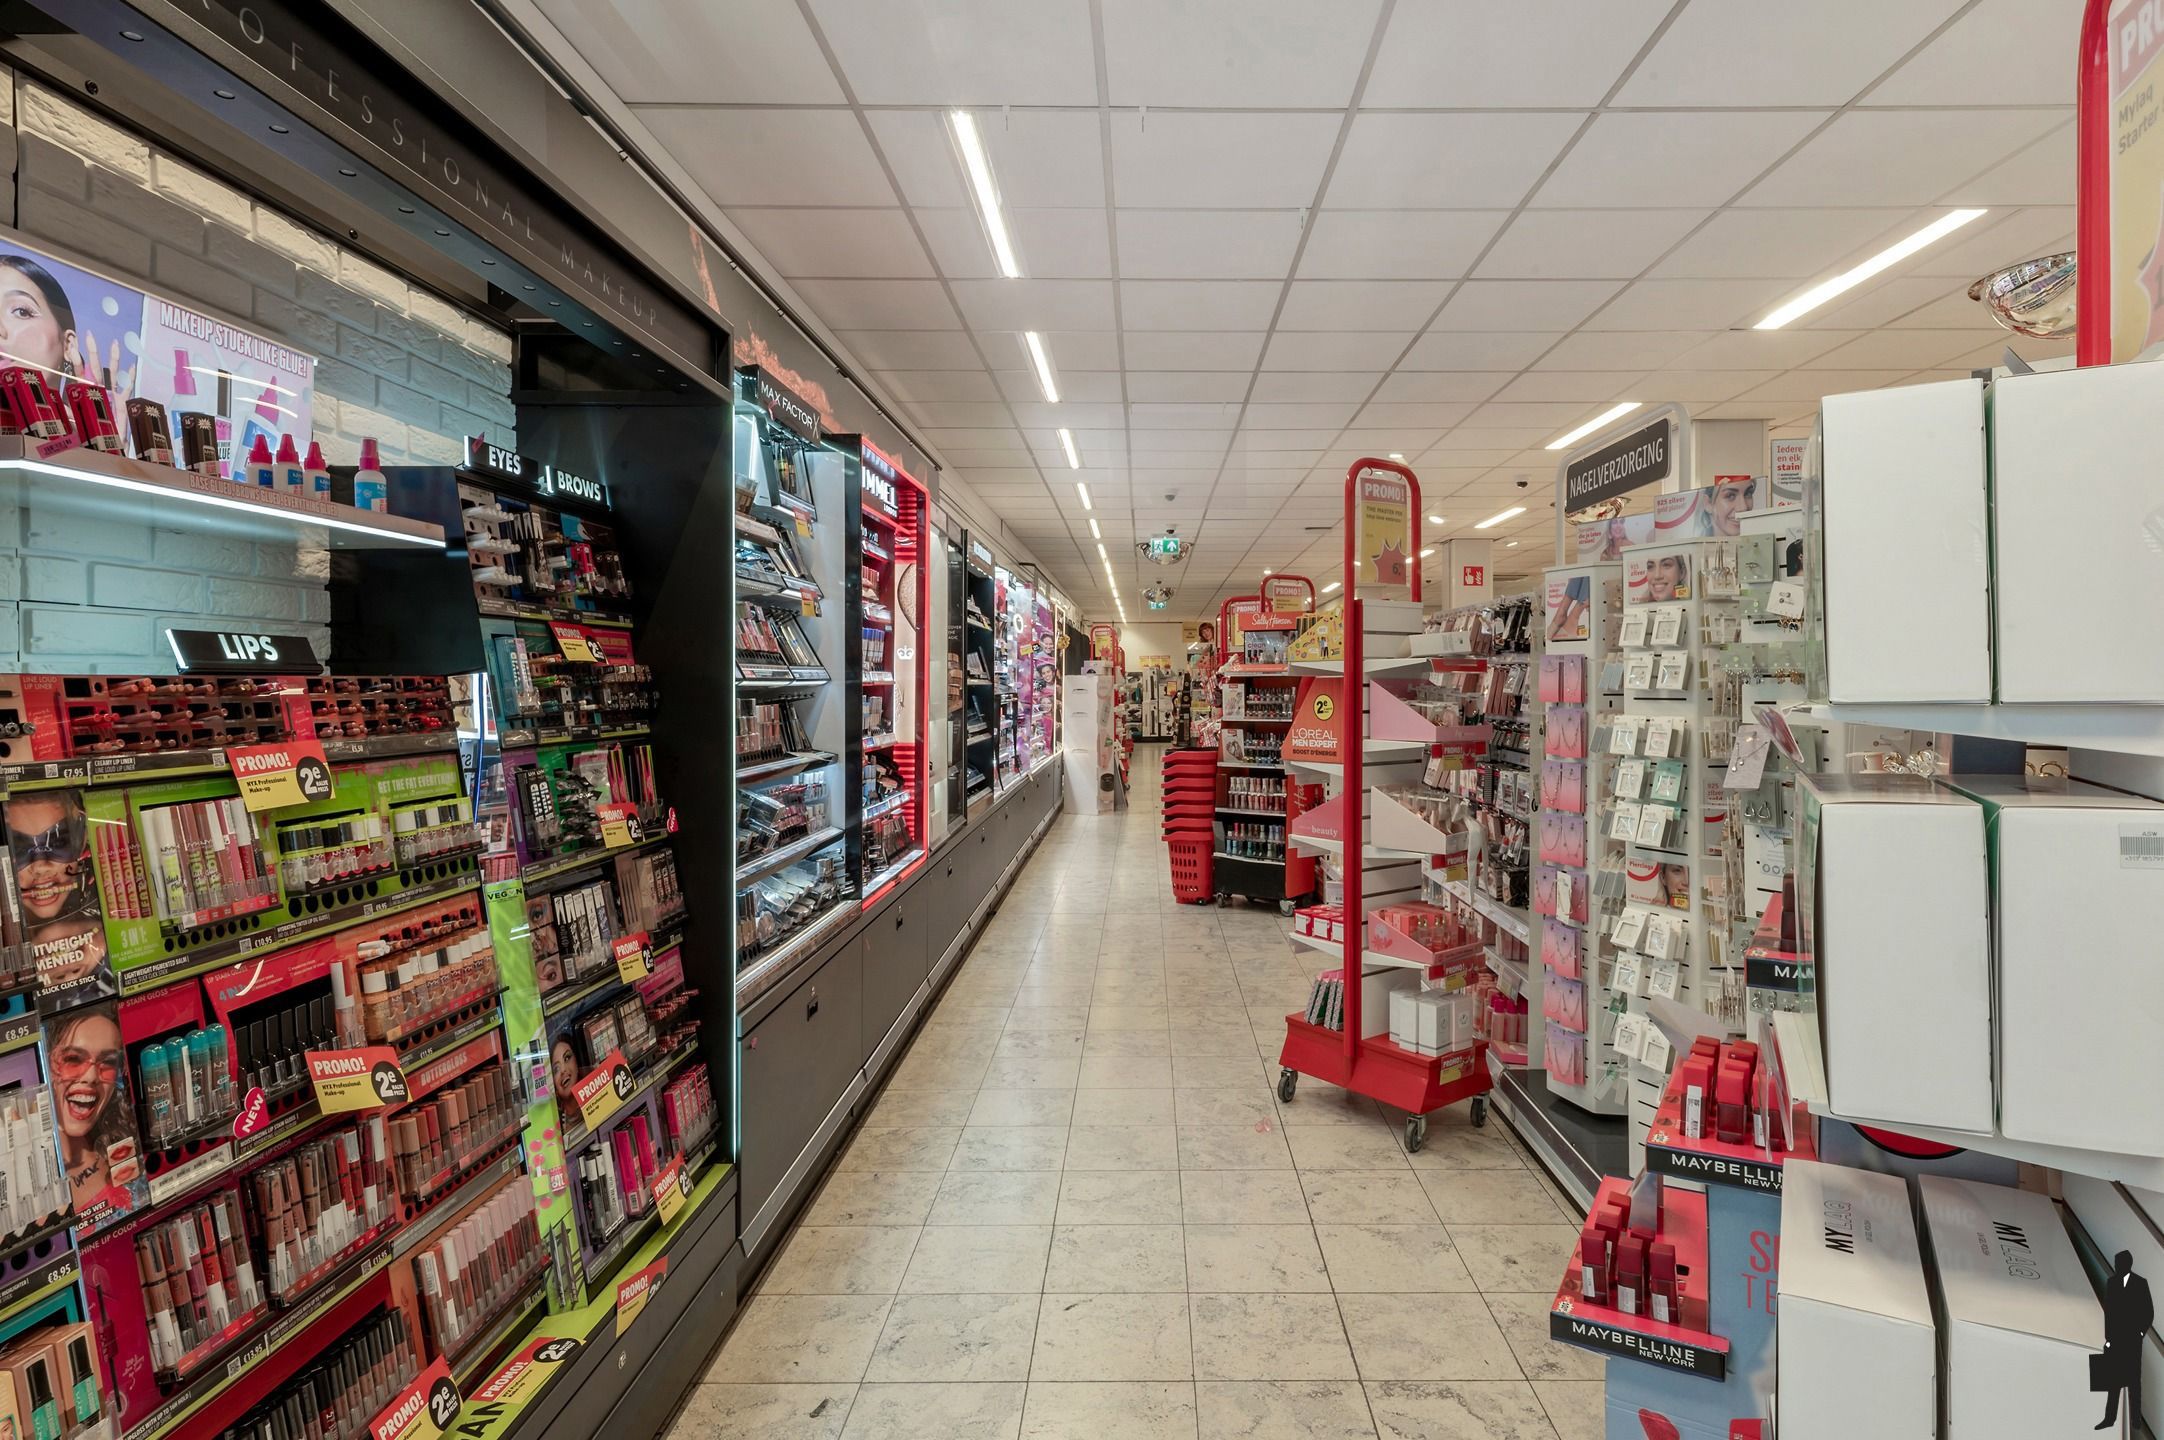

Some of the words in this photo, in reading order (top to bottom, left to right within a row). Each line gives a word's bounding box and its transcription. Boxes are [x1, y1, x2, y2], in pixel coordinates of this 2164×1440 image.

[2119, 84, 2153, 128] Mylaq
[2119, 106, 2159, 154] Starter
[203, 0, 535, 242] OFESSIONAL
[560, 242, 660, 326] MAKEUP
[160, 302, 213, 342] MAKEUP
[215, 323, 252, 358] STUCK
[255, 337, 278, 367] LIKE
[279, 349, 308, 378] GLUE!
[761, 382, 781, 405] MAX
[782, 397, 813, 428] FACTOR
[488, 444, 521, 476] EYES
[1569, 437, 1664, 499] NAGELVERZORGING
[189, 474, 208, 490] BASE
[236, 485, 260, 501] BROWS
[557, 472, 601, 502] BROWS
[1364, 482, 1405, 502] PROMO!
[1276, 587, 1301, 595] PROMO!
[1236, 605, 1259, 613] PROMO!
[1252, 613, 1268, 629] Sally
[1269, 613, 1292, 628] Hansen
[555, 627, 583, 639] PROMO!
[217, 633, 279, 661] LIPS
[1316, 700, 1328, 714] 2e
[1292, 727, 1337, 740] L'ORÉAL
[1292, 739, 1309, 747] MEN
[1309, 739, 1337, 749] EXPERT
[237, 752, 291, 773] PROMO!
[249, 786, 271, 794] Make-up
[257, 777, 287, 786] Professional
[378, 781, 391, 794] GET
[392, 779, 404, 792] THE
[404, 777, 416, 790] FAT
[599, 809, 624, 823] PROMO!
[1311, 824, 1338, 838] beauty
[487, 888, 523, 900] VEGN
[121, 929, 128, 947] 3
[129, 928, 140, 947] IN
[616, 940, 640, 957] PROMO!
[124, 967, 152, 980] LIGHTWEIGHT
[152, 962, 177, 974] PIGMENTED
[216, 970, 230, 980] STAIN
[1446, 963, 1465, 976] PROMO!
[42, 985, 60, 995] SLICK
[126, 994, 148, 1007] STAIN
[148, 988, 169, 1001] GLOSS
[313, 1056, 366, 1077] PROMO!
[147, 1083, 170, 1092] NYX
[324, 1089, 345, 1097] Make-up
[332, 1080, 361, 1088] Professional
[577, 1070, 610, 1102] PROMO!
[242, 1093, 265, 1133] NEW
[654, 1168, 676, 1198] PROMO!
[1744, 1178, 1767, 1186] NEW
[92, 1202, 107, 1213] WET
[94, 1208, 113, 1221] STAIN
[113, 1220, 138, 1239] COLOR
[1824, 1200, 1854, 1254] MYLAQ
[1992, 1221, 2041, 1280] MYLAQ
[620, 1275, 648, 1303] PROMO!
[1572, 1321, 1695, 1361] MAYBELLINE
[1638, 1349, 1664, 1361] NEW
[1665, 1355, 1696, 1369] YORK
[481, 1361, 528, 1398] PROMO!
[378, 1390, 424, 1440] PROMO!
[456, 1402, 506, 1440] AN
[145, 1419, 156, 1431] WITH
